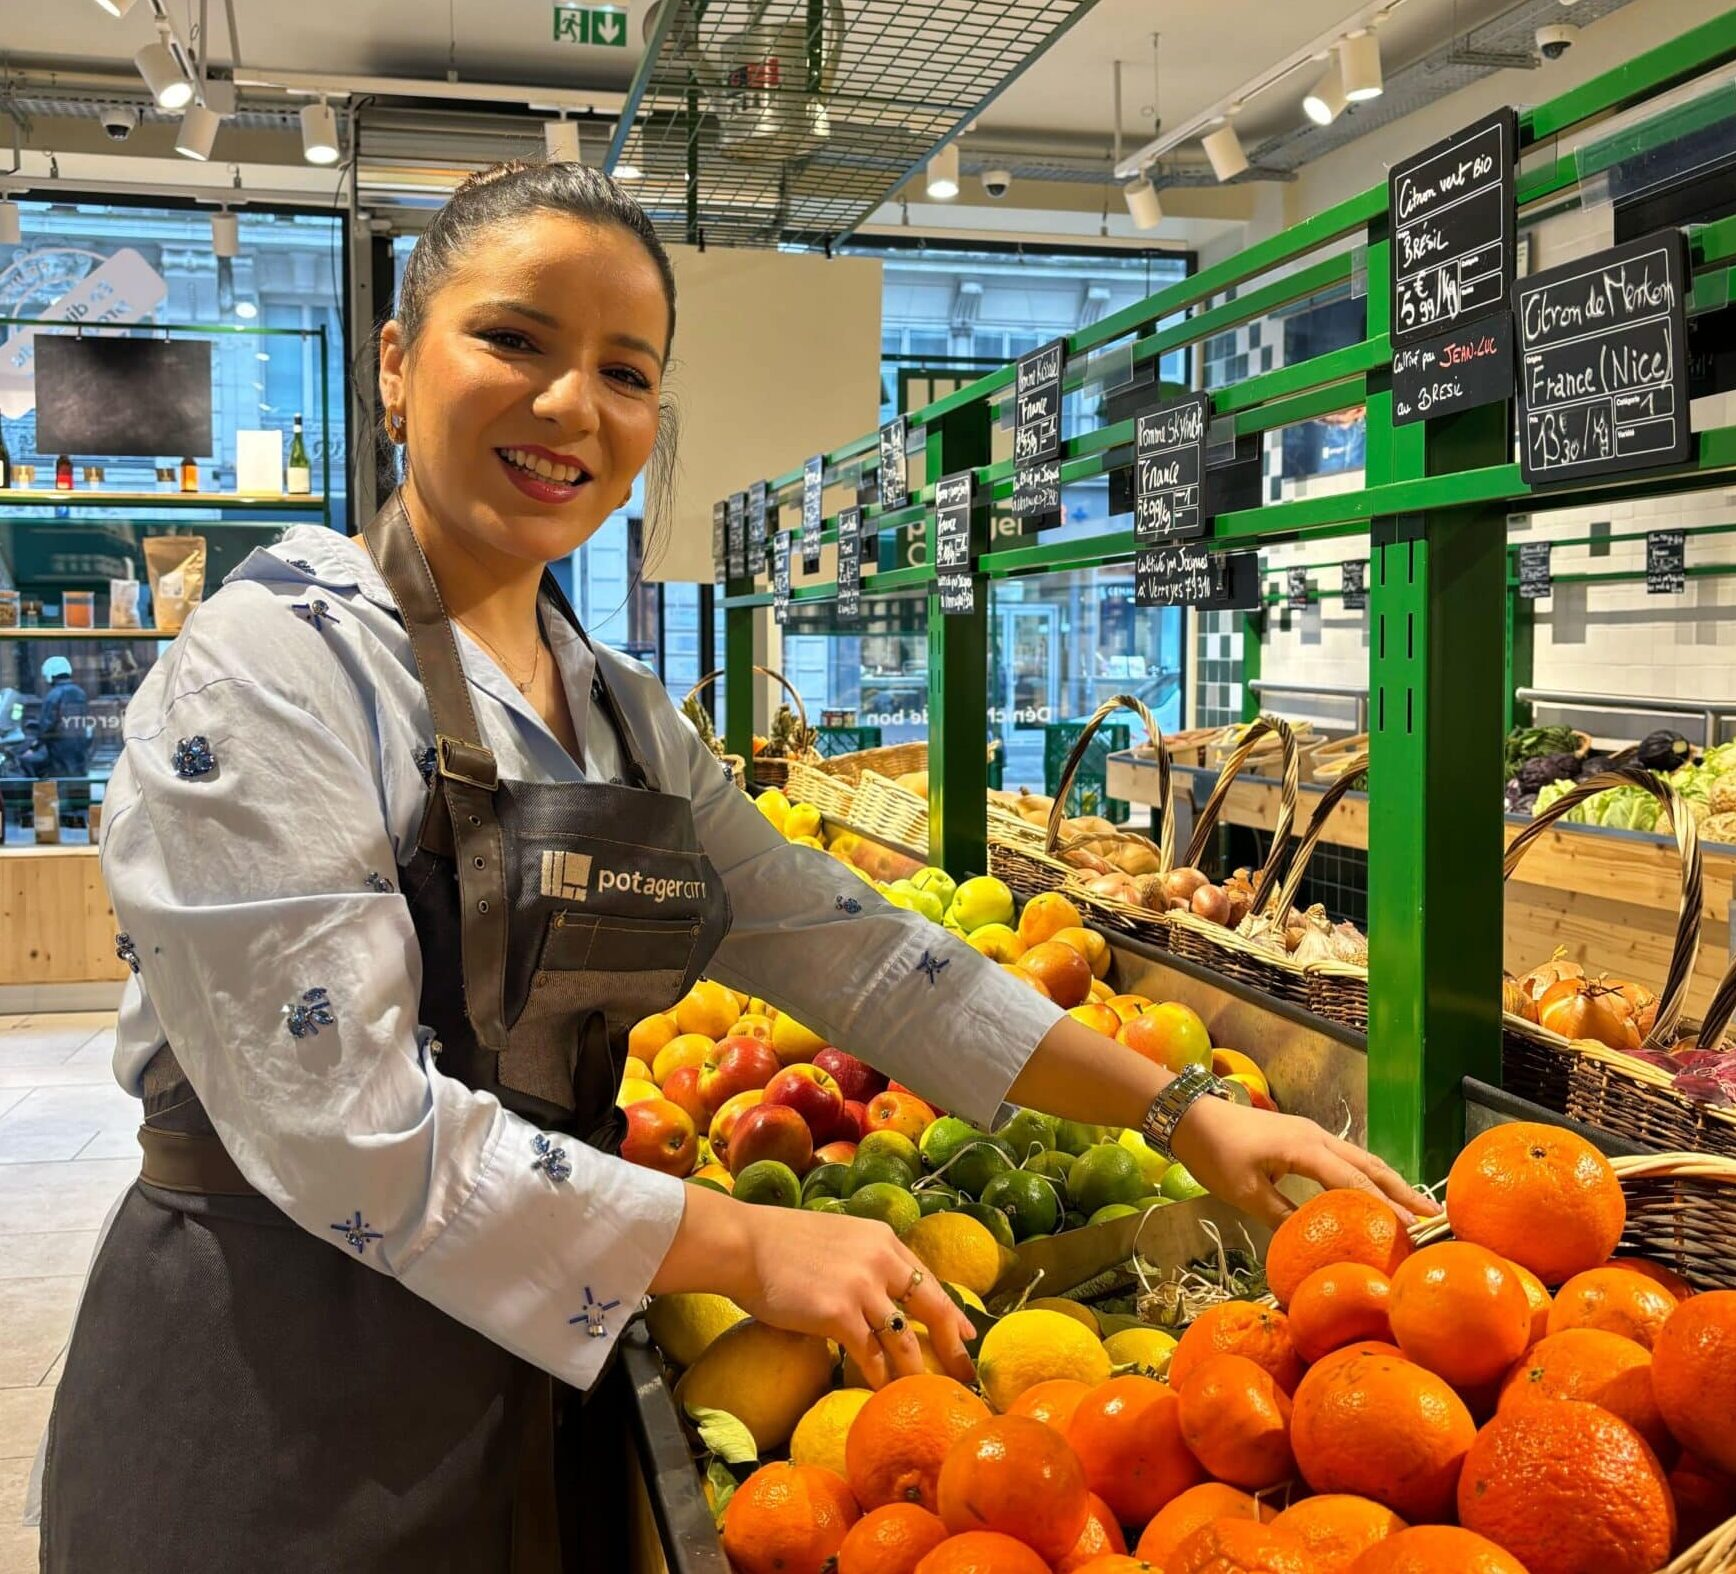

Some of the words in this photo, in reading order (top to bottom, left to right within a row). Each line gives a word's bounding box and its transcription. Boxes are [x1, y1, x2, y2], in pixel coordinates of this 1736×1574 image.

[1399, 178, 1436, 218] Citron
[1440, 161, 1473, 192] vert
[1525, 290, 1582, 342] Citron
[1585, 284, 1606, 319] de
[1603, 265, 1675, 318] Menton
[1532, 365, 1596, 404] France
[1138, 418, 1166, 447] Pomme
[1143, 460, 1179, 495] France
